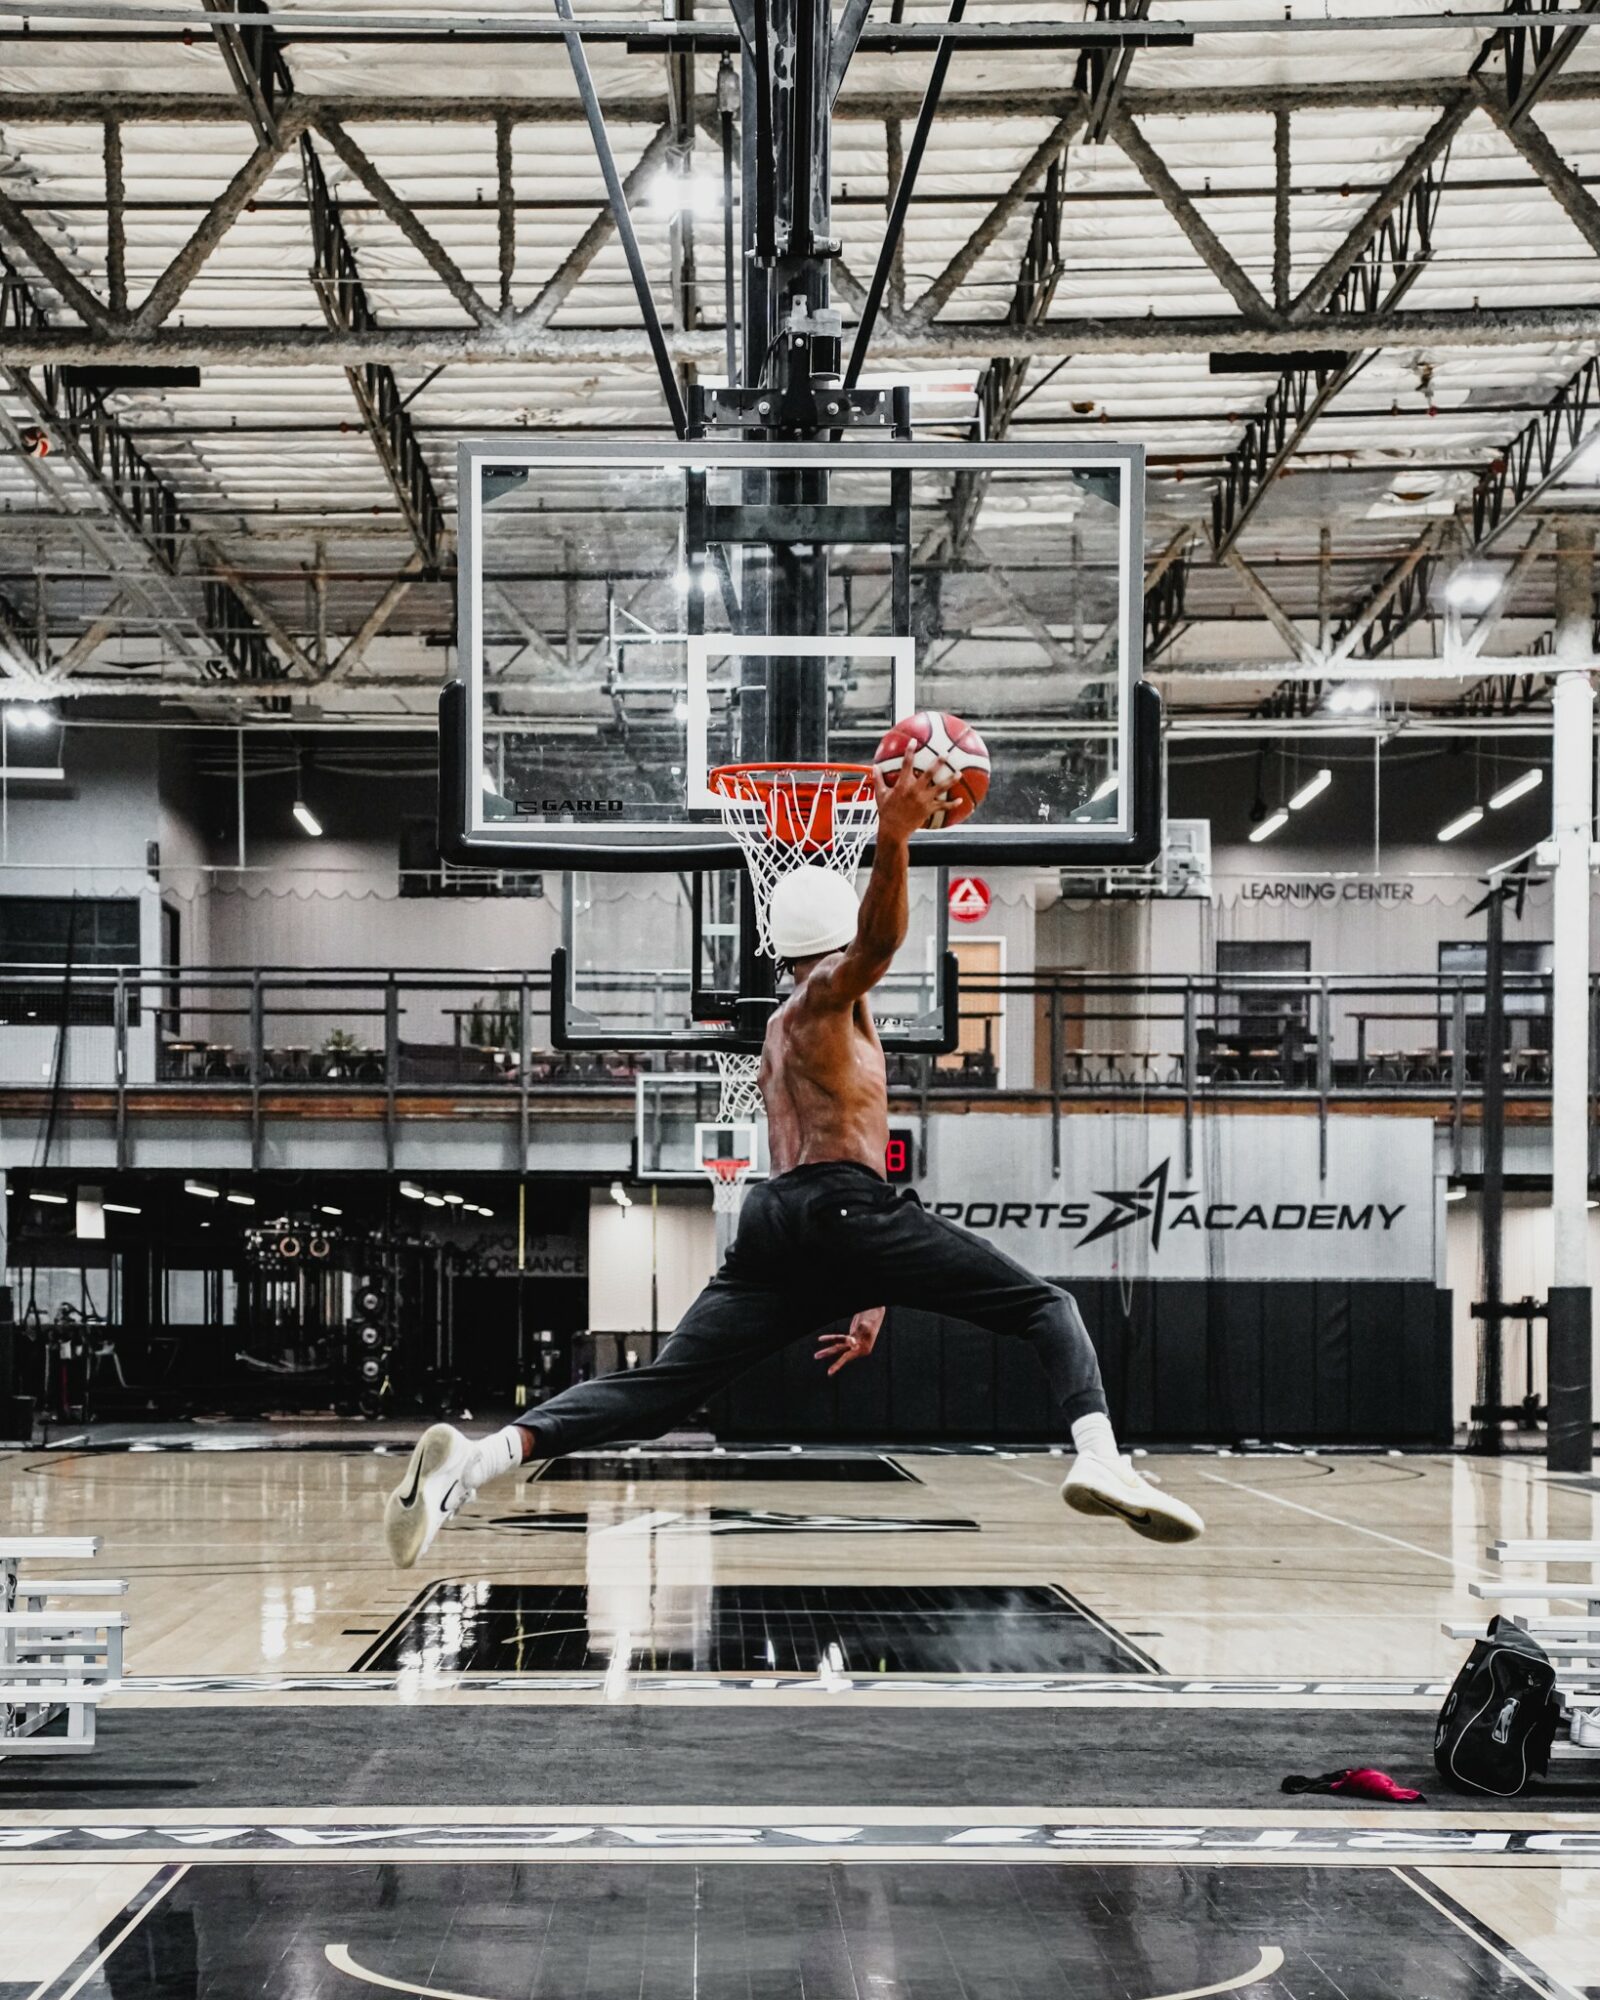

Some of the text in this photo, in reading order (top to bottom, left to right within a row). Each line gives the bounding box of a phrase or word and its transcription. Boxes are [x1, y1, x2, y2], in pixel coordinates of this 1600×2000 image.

[542, 799, 623, 811] GARED
[1241, 882, 1414, 900] LEARNING CENTER
[923, 1202, 1091, 1229] PORTS
[1168, 1204, 1408, 1230] ACADEMY
